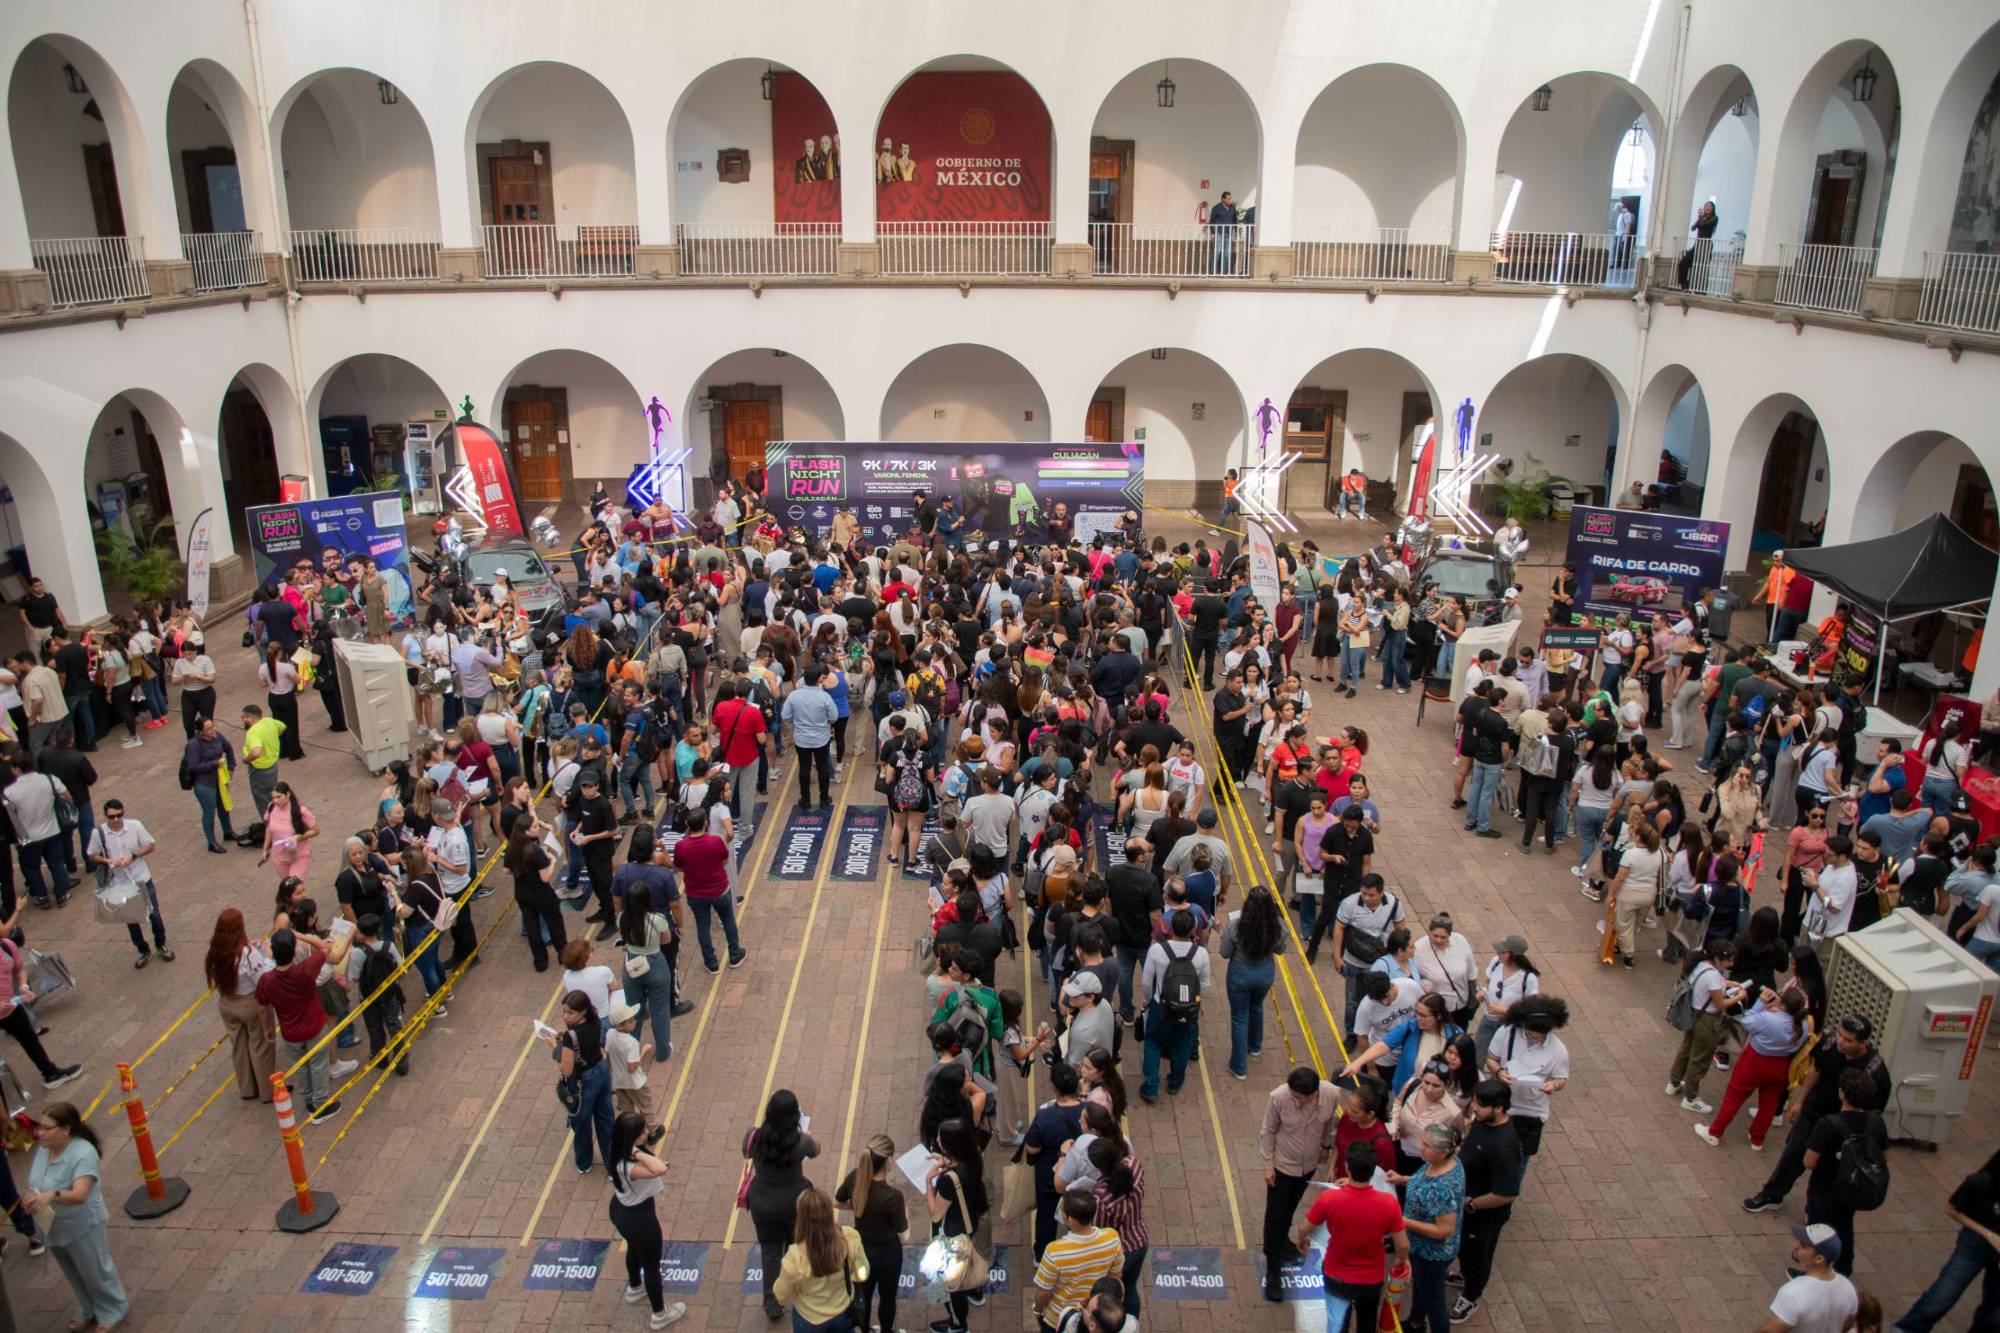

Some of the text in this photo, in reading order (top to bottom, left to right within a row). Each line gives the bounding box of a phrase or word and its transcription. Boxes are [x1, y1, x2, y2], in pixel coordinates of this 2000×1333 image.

[936, 158, 1021, 168] GOBIERNO DE
[936, 168, 1022, 186] MÉXICO
[1053, 452, 1100, 460] CULIACÁN
[789, 460, 840, 469] FLASH
[862, 460, 881, 471] 9K
[890, 460, 908, 470] 7K
[918, 460, 937, 470] 3K
[790, 470, 840, 479] NIGHT
[791, 479, 840, 495] RUN
[261, 511, 296, 521] FLASH
[263, 519, 296, 527] NIGHT
[1588, 514, 1613, 522] FLASH
[264, 524, 297, 538] RUN
[1587, 525, 1612, 533] RUN
[1593, 555, 1700, 576] RIFA DE CARRO
[781, 833, 815, 874] 1501-2000
[844, 833, 875, 875] 2001-2500
[1382, 1006, 1413, 1025] adidas
[317, 1267, 374, 1285] 001-500
[531, 1264, 598, 1279] 1001-1500
[426, 1272, 490, 1288] 501-1000
[1155, 1274, 1224, 1288] 4001-4500
